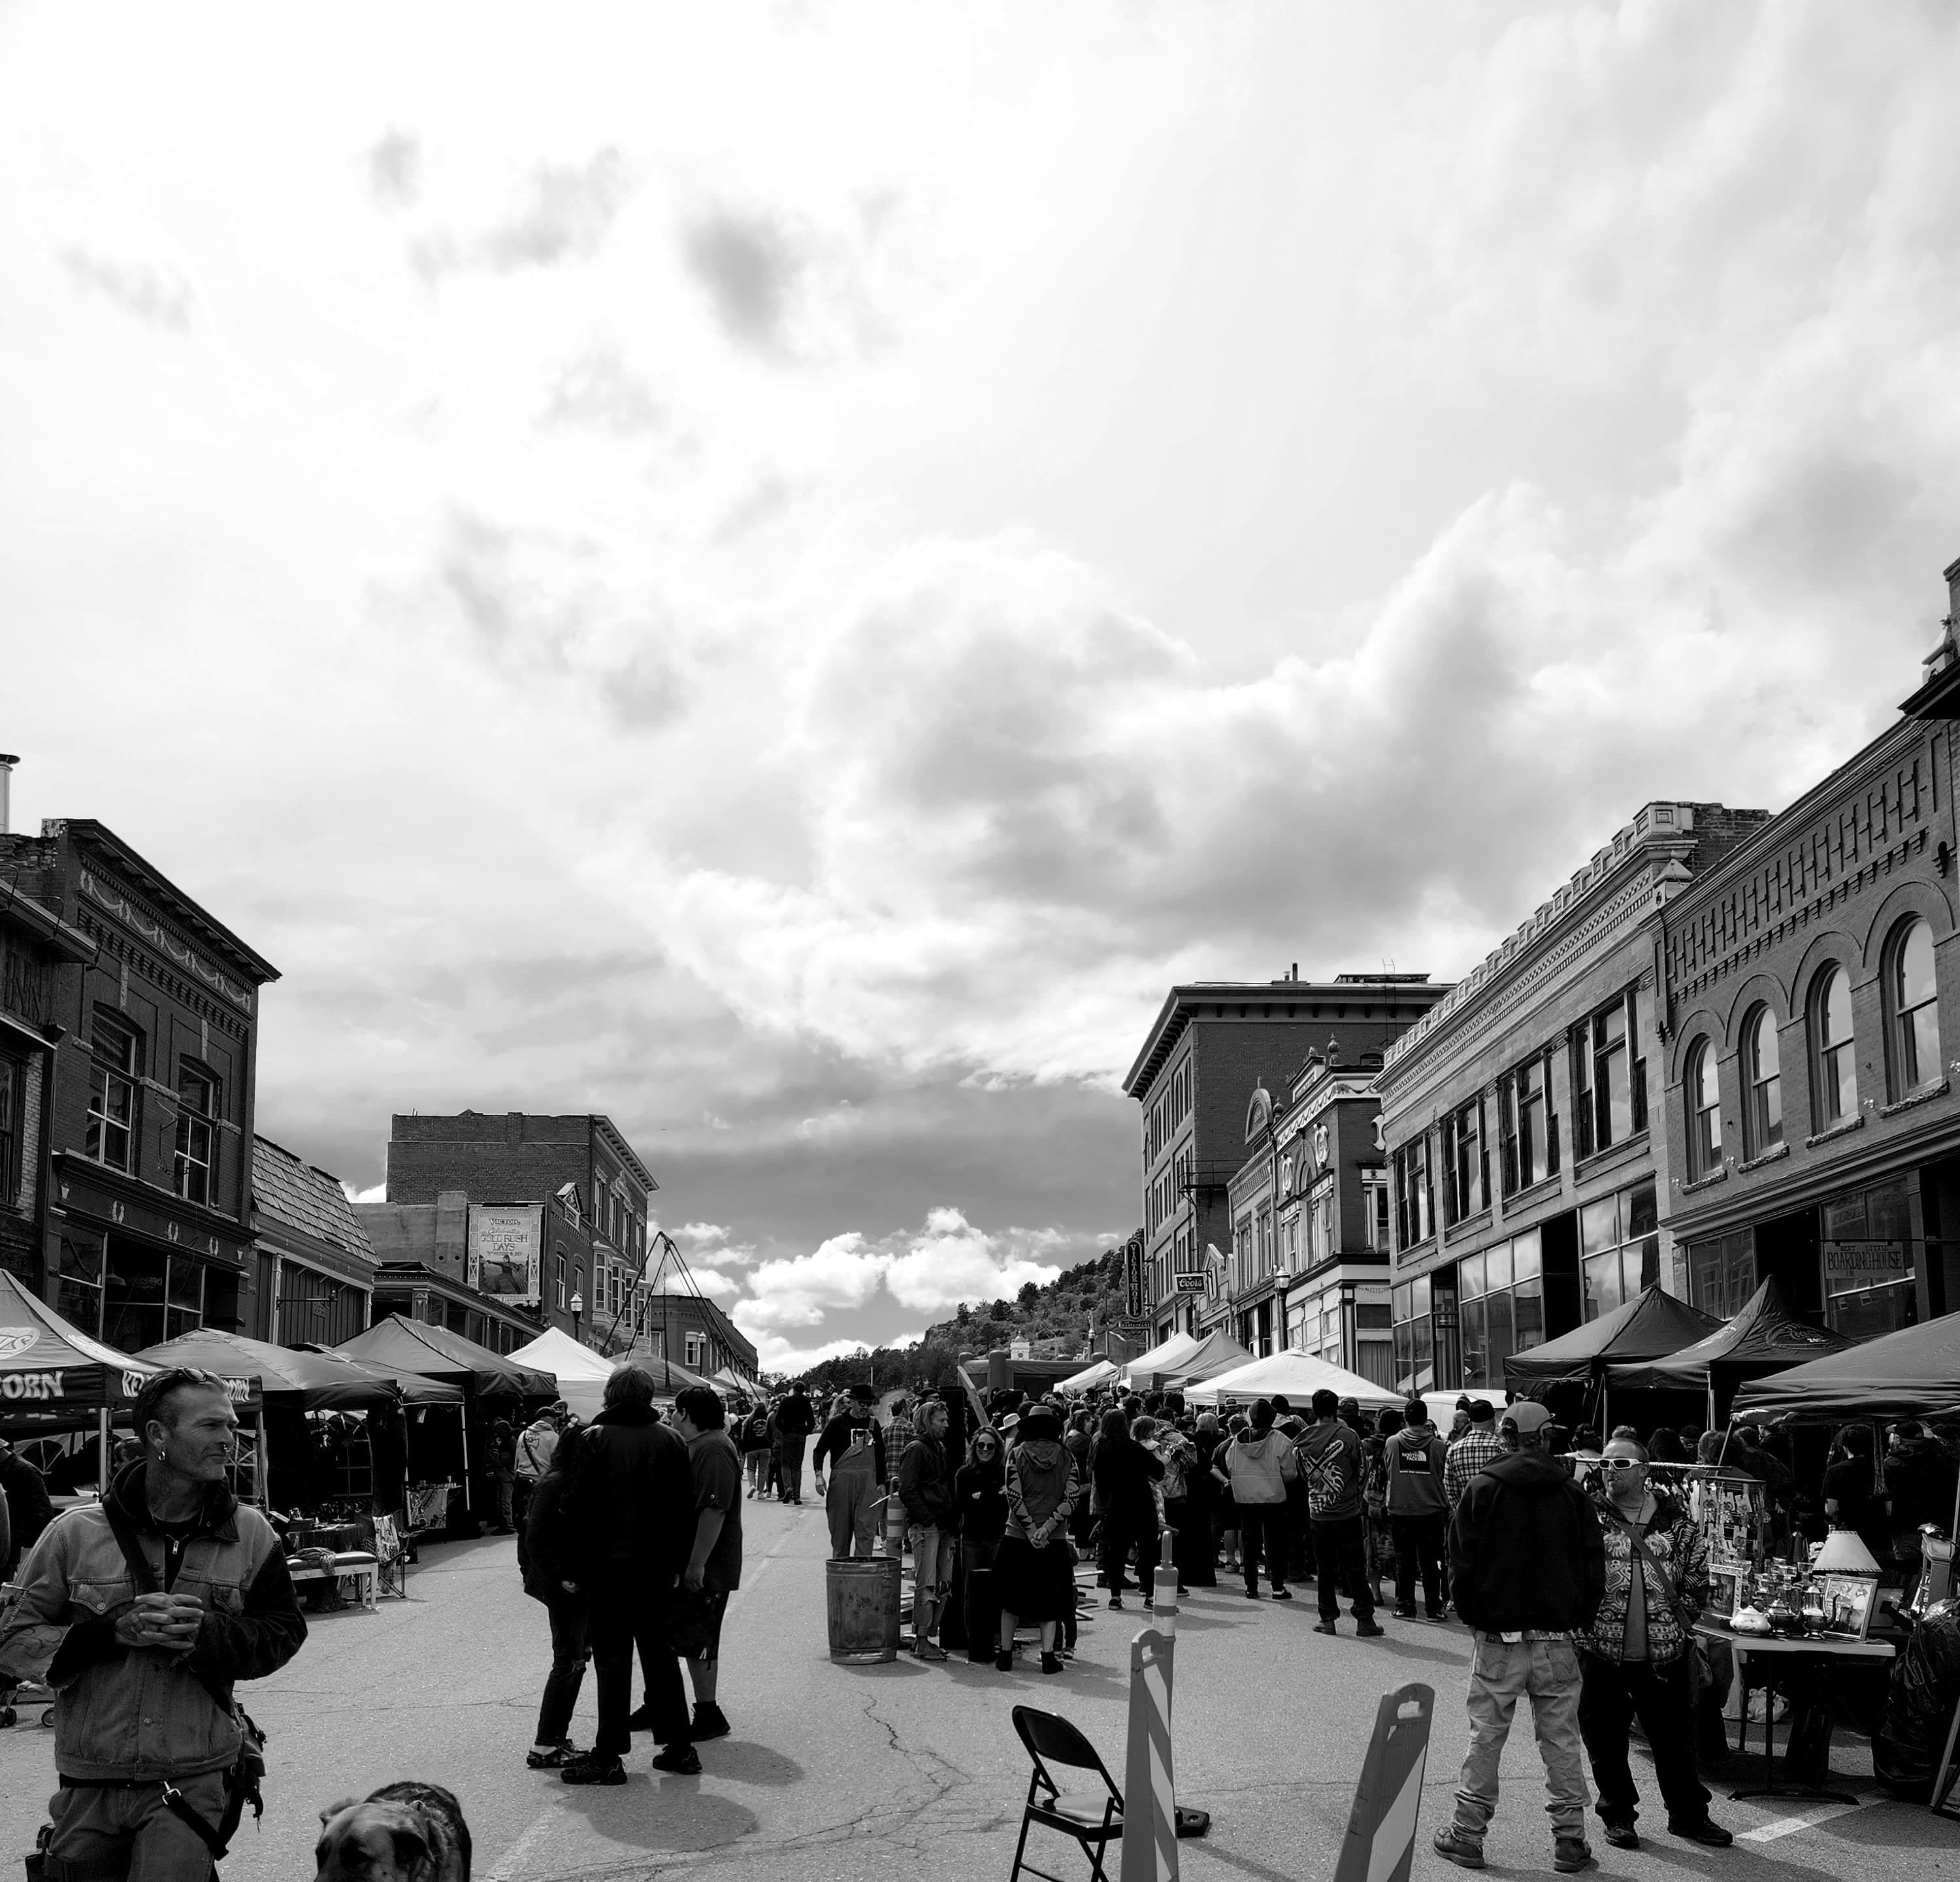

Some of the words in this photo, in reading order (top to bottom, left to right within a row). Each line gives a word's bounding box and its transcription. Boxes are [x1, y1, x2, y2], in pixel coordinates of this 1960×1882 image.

[480, 1234, 502, 1242] GOLD
[504, 1234, 529, 1243] RUSH
[492, 1242, 515, 1251] DAYS
[1130, 1244, 1138, 1282] VICTOR
[1178, 1278, 1203, 1287] Coors
[1129, 1283, 1139, 1316] HOTEL
[0, 1370, 64, 1401] ORN
